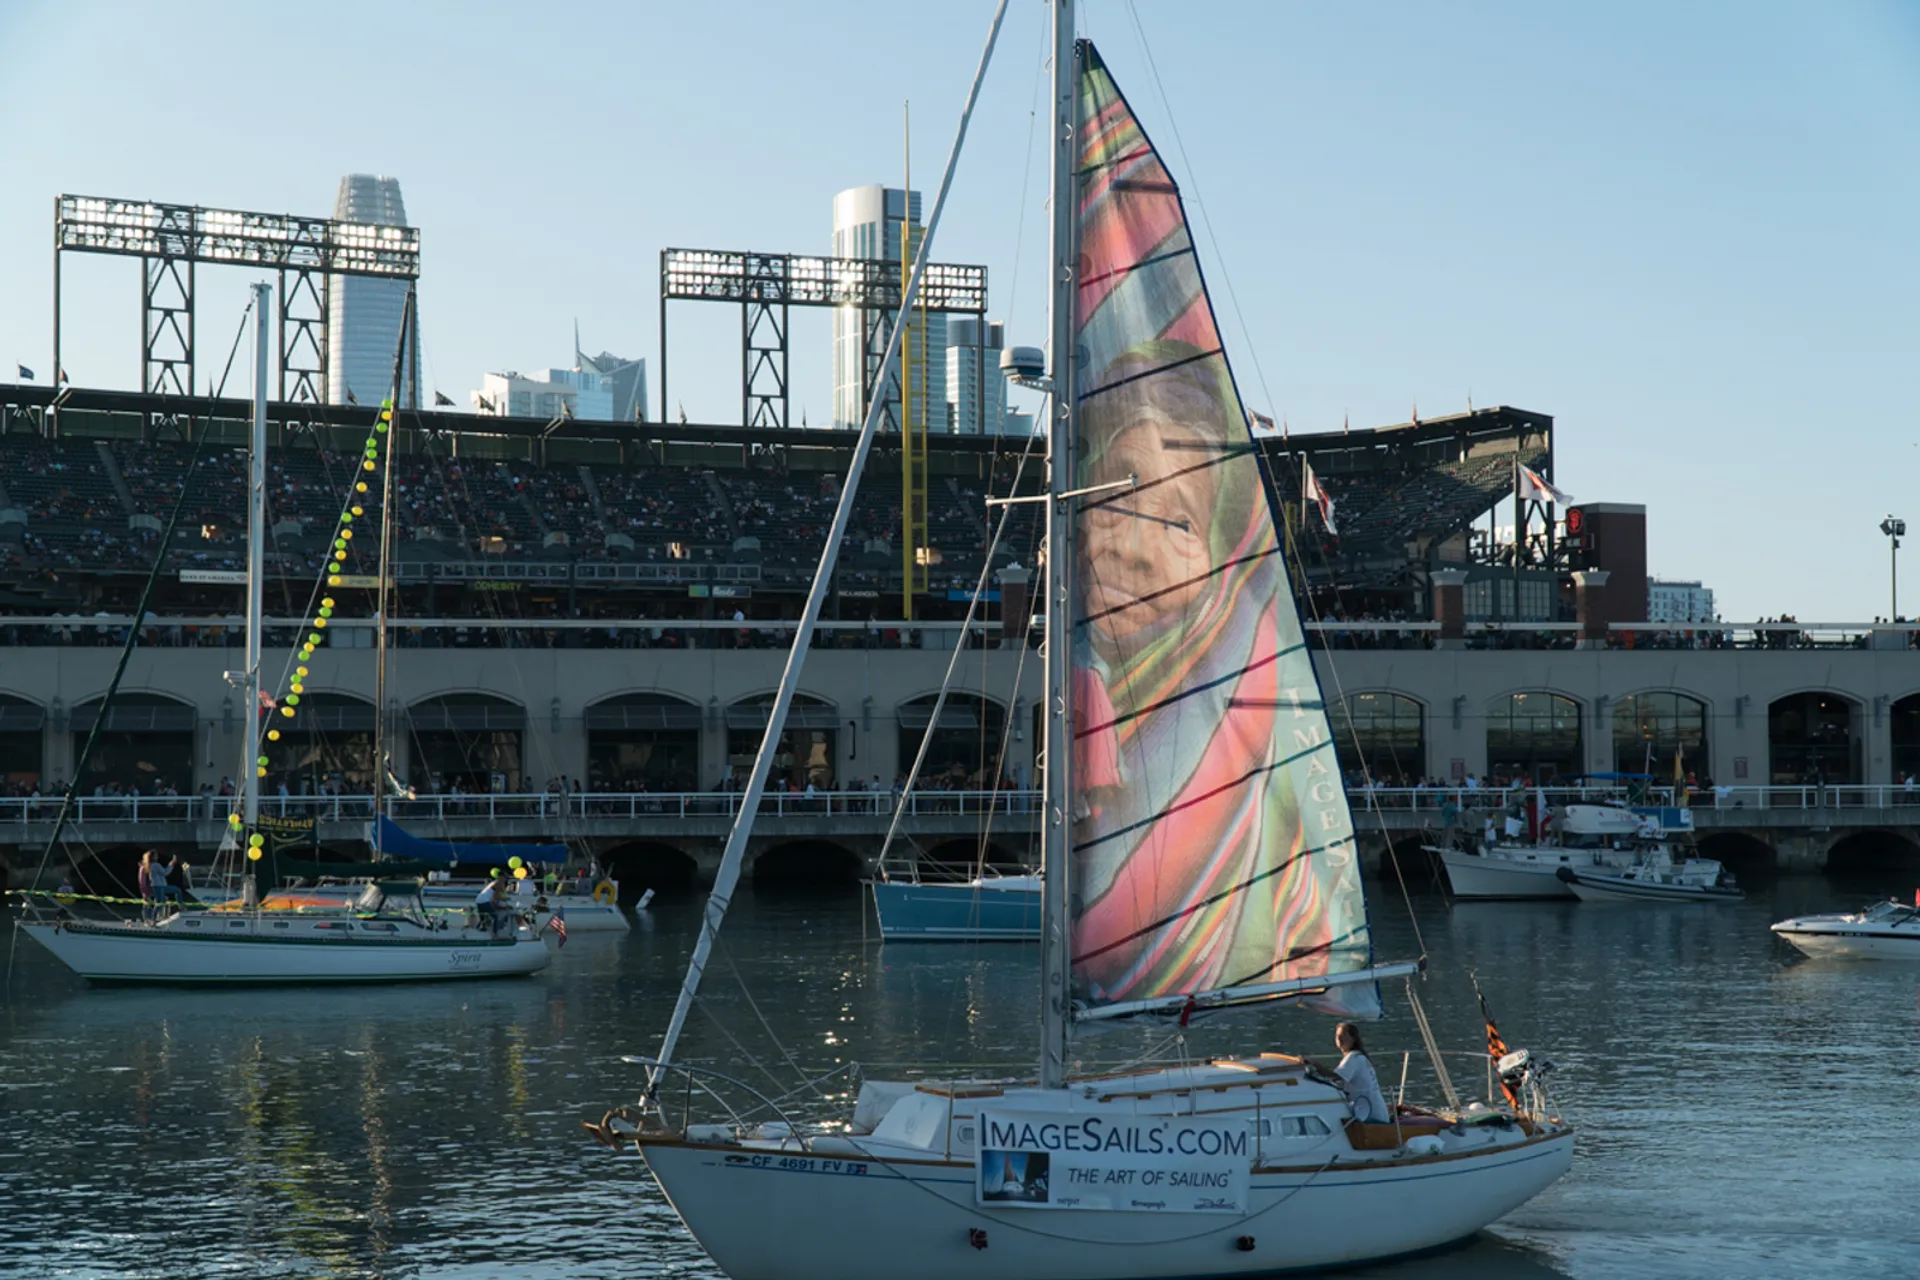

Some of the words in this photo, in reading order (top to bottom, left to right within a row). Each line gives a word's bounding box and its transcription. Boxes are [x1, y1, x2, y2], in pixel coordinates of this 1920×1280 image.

[448, 950, 482, 966] Spirit
[751, 1156, 773, 1167] CF
[779, 1158, 815, 1171] 4691
[822, 1161, 842, 1172] FV
[1068, 1167, 1099, 1184] THE
[1104, 1169, 1137, 1185] ART
[1141, 1171, 1165, 1187] OF
[1168, 1170, 1230, 1188] SAILING
